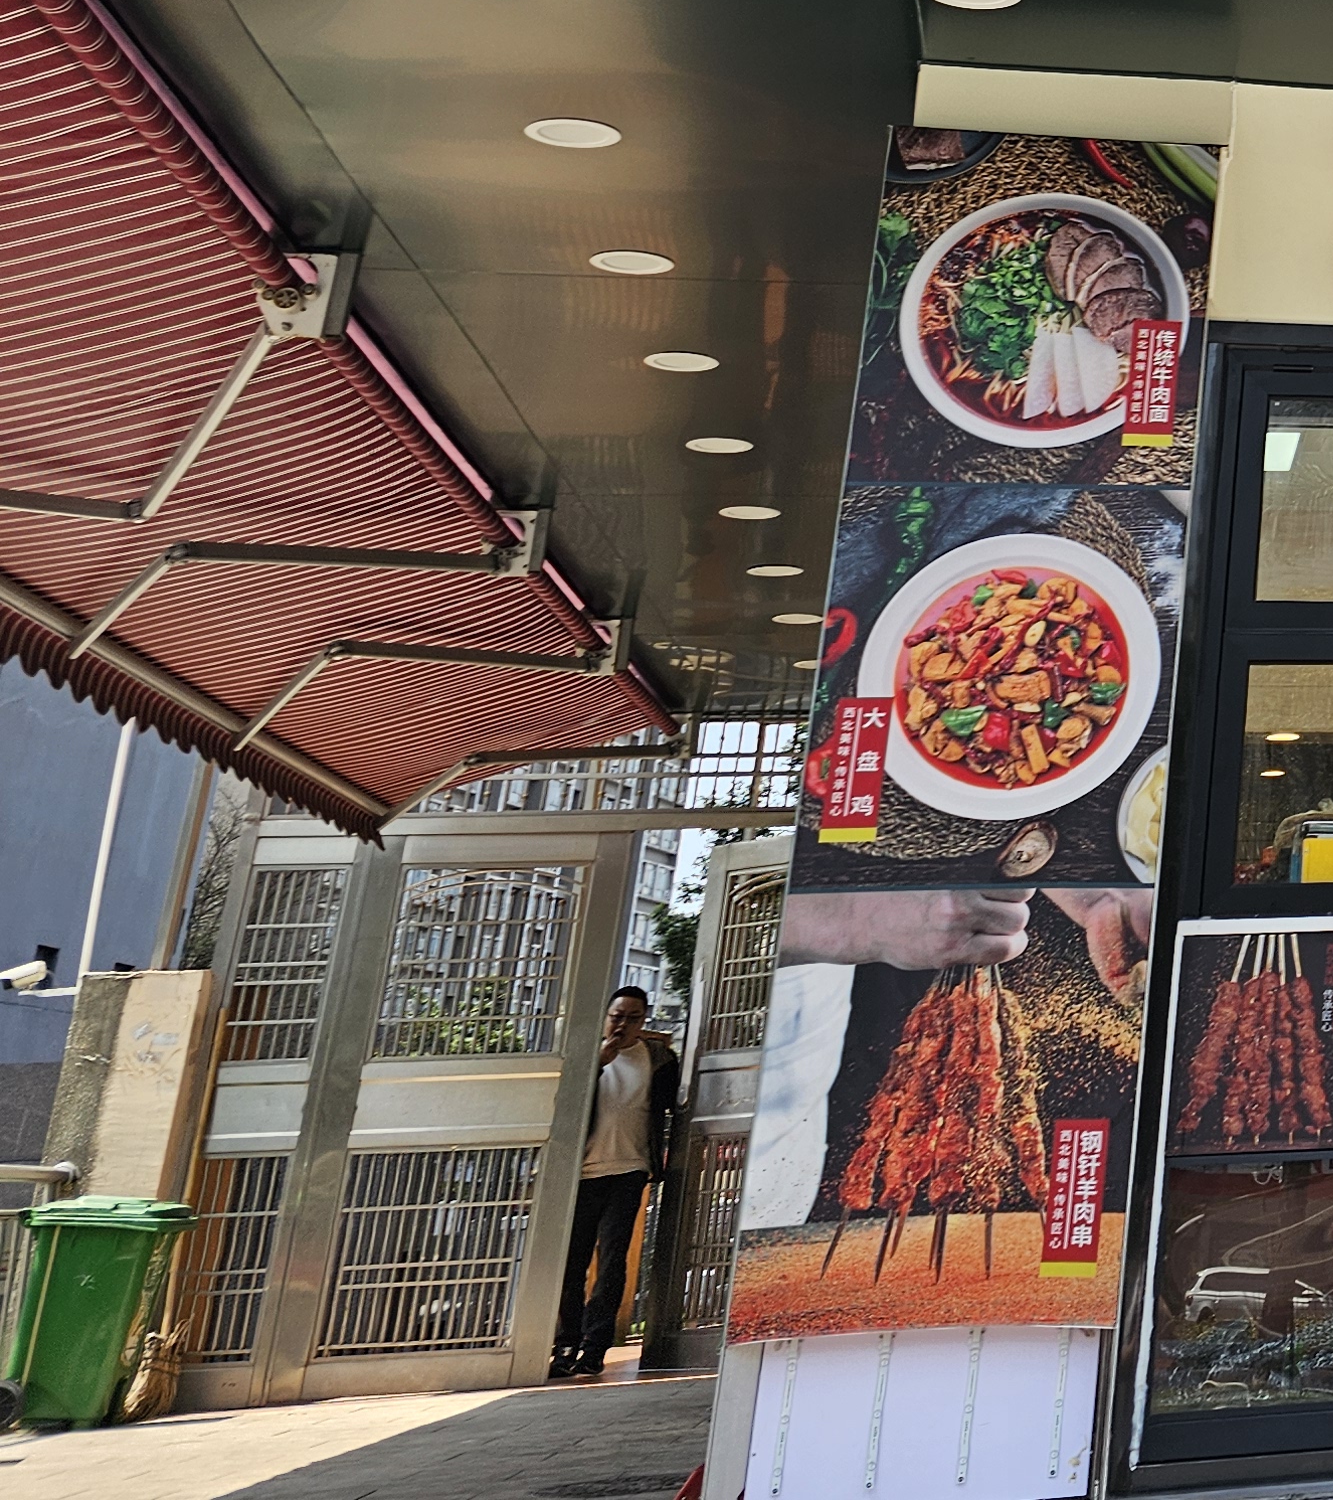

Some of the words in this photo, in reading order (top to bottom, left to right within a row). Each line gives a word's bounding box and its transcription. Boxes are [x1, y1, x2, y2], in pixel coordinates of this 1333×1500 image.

[1148, 329, 1177, 423] 传统牛肉面
[850, 707, 887, 818] 大盘鸡
[1070, 1128, 1104, 1248] 钢钎羊肉串
